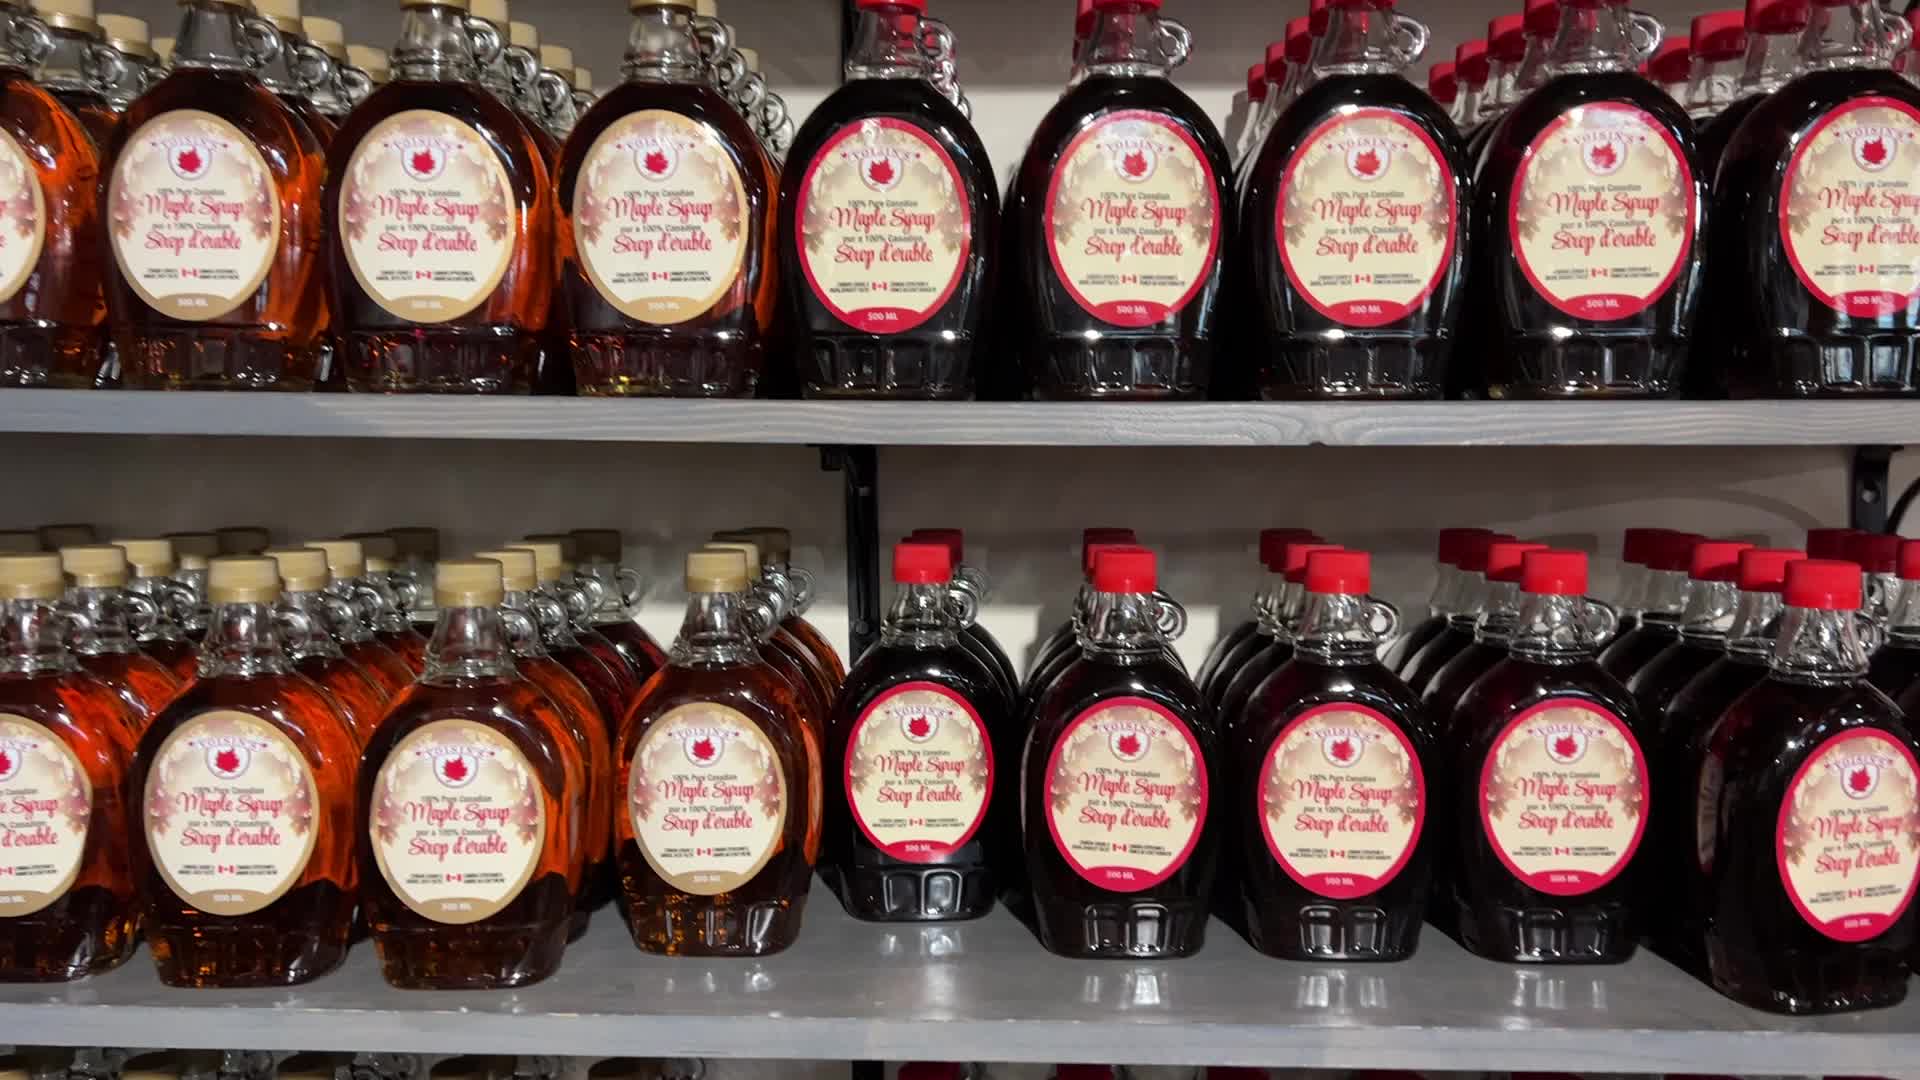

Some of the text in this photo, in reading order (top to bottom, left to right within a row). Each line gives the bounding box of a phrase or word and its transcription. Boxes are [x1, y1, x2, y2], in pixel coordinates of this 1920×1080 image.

[139, 191, 243, 222] Maple Syrup
[371, 193, 479, 224] Maple Syrup
[606, 195, 713, 223] Maple Syrup
[1080, 195, 1185, 228] Maple Syrup
[1311, 195, 1421, 225] Maple Syrup
[1546, 189, 1658, 218] Maple Syrup
[829, 203, 934, 234] Maple Syrup
[144, 230, 184, 256] Sirop
[377, 232, 417, 257] Sirop
[613, 234, 653, 259] Sirop
[834, 243, 875, 269] Sirop
[1084, 235, 1125, 261] Sirop
[1316, 236, 1358, 261] Sirop
[1551, 230, 1595, 256] Sirop
[873, 752, 964, 778] Maple Syrup
[656, 778, 754, 804] Maple Syrup
[877, 786, 912, 807] Sirop
[1076, 770, 1175, 803] Maple Syrup
[1291, 777, 1391, 807] Maple Syrup
[1514, 775, 1615, 803] Maple Syrup
[175, 790, 282, 819] Maple Syrup
[402, 799, 509, 828] Maple Syrup
[662, 814, 698, 836] Sirop
[1078, 806, 1117, 830] Sirop
[1294, 813, 1333, 837] Sirop
[1518, 811, 1558, 834] Sirop
[180, 828, 221, 852] Sirop
[408, 837, 448, 861] Sirop
